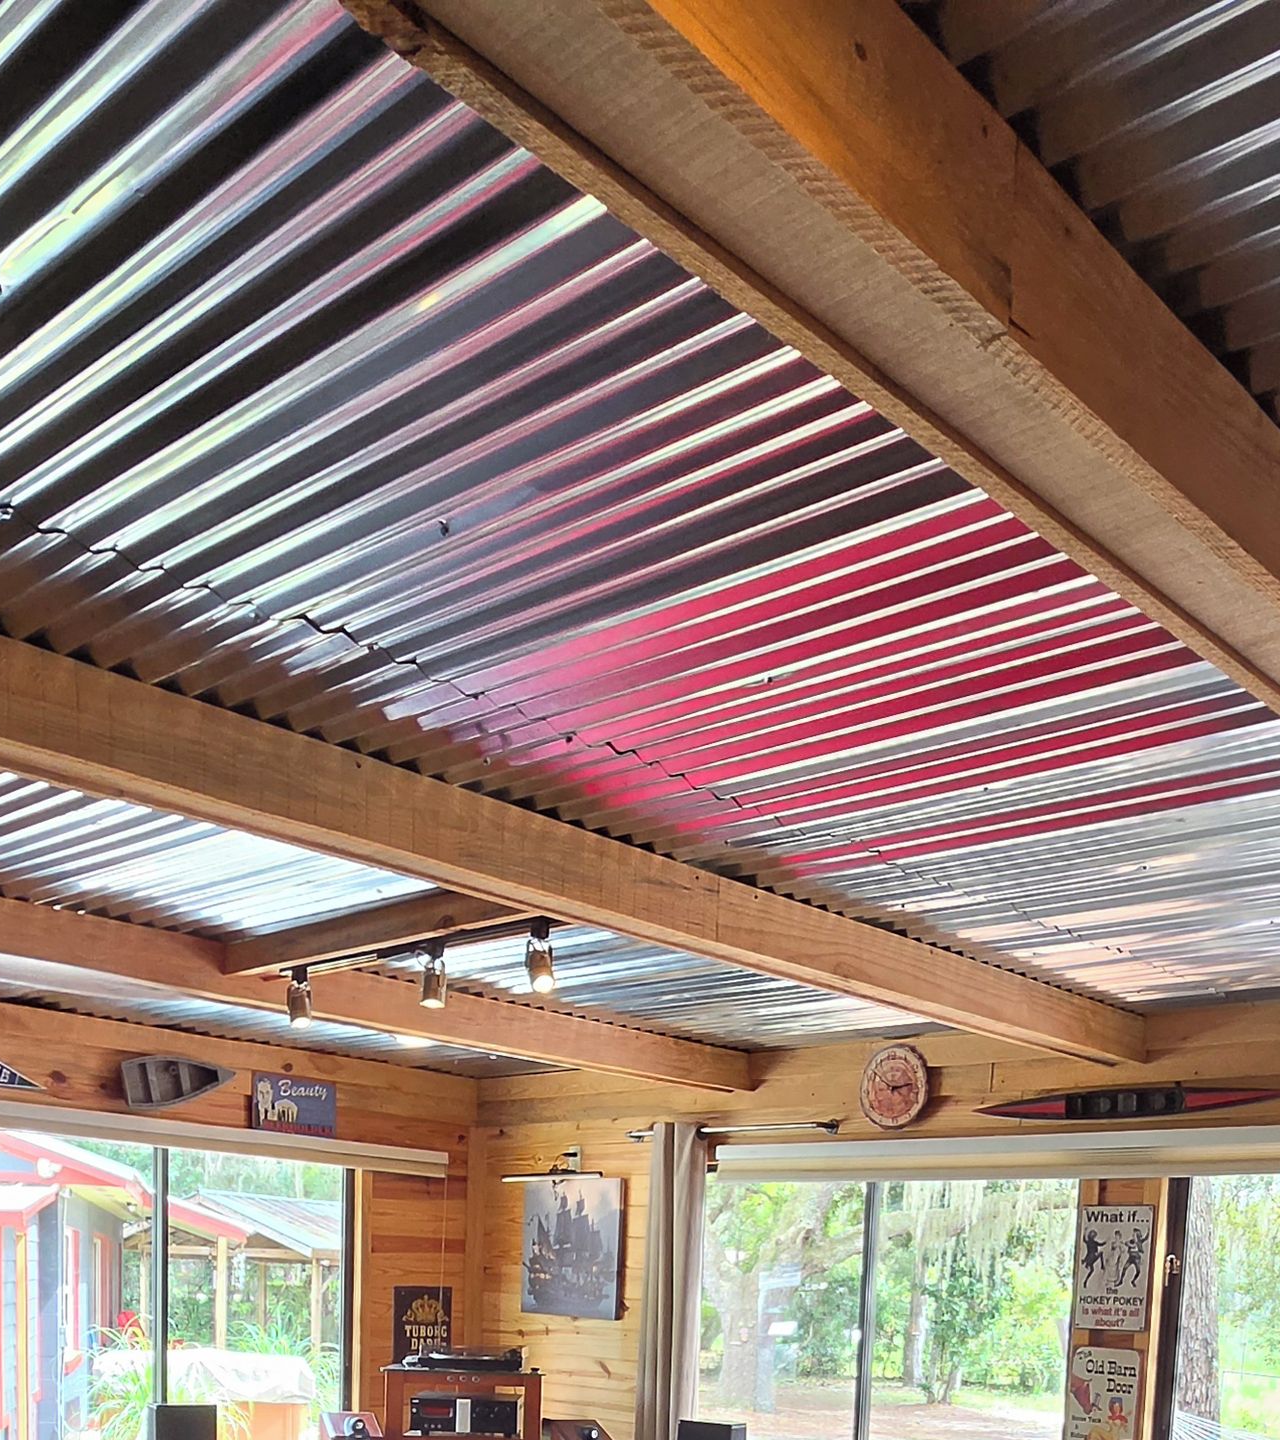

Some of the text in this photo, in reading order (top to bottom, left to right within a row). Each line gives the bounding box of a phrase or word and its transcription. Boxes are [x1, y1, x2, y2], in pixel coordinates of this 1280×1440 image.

[278, 1079, 329, 1101] Beauty
[1085, 1210, 1150, 1223] What if...
[1105, 1287, 1119, 1295] the
[1079, 1295, 1145, 1308] HOKEY POKEY
[1091, 1307, 1112, 1317] what
[1113, 1307, 1127, 1317] it's
[1128, 1308, 1141, 1318] all
[1094, 1318, 1125, 1328] about?
[404, 1324, 448, 1338] TUBORG
[1076, 1350, 1092, 1360] The
[1085, 1359, 1137, 1378] Old Barn
[1106, 1378, 1134, 1395] Door
